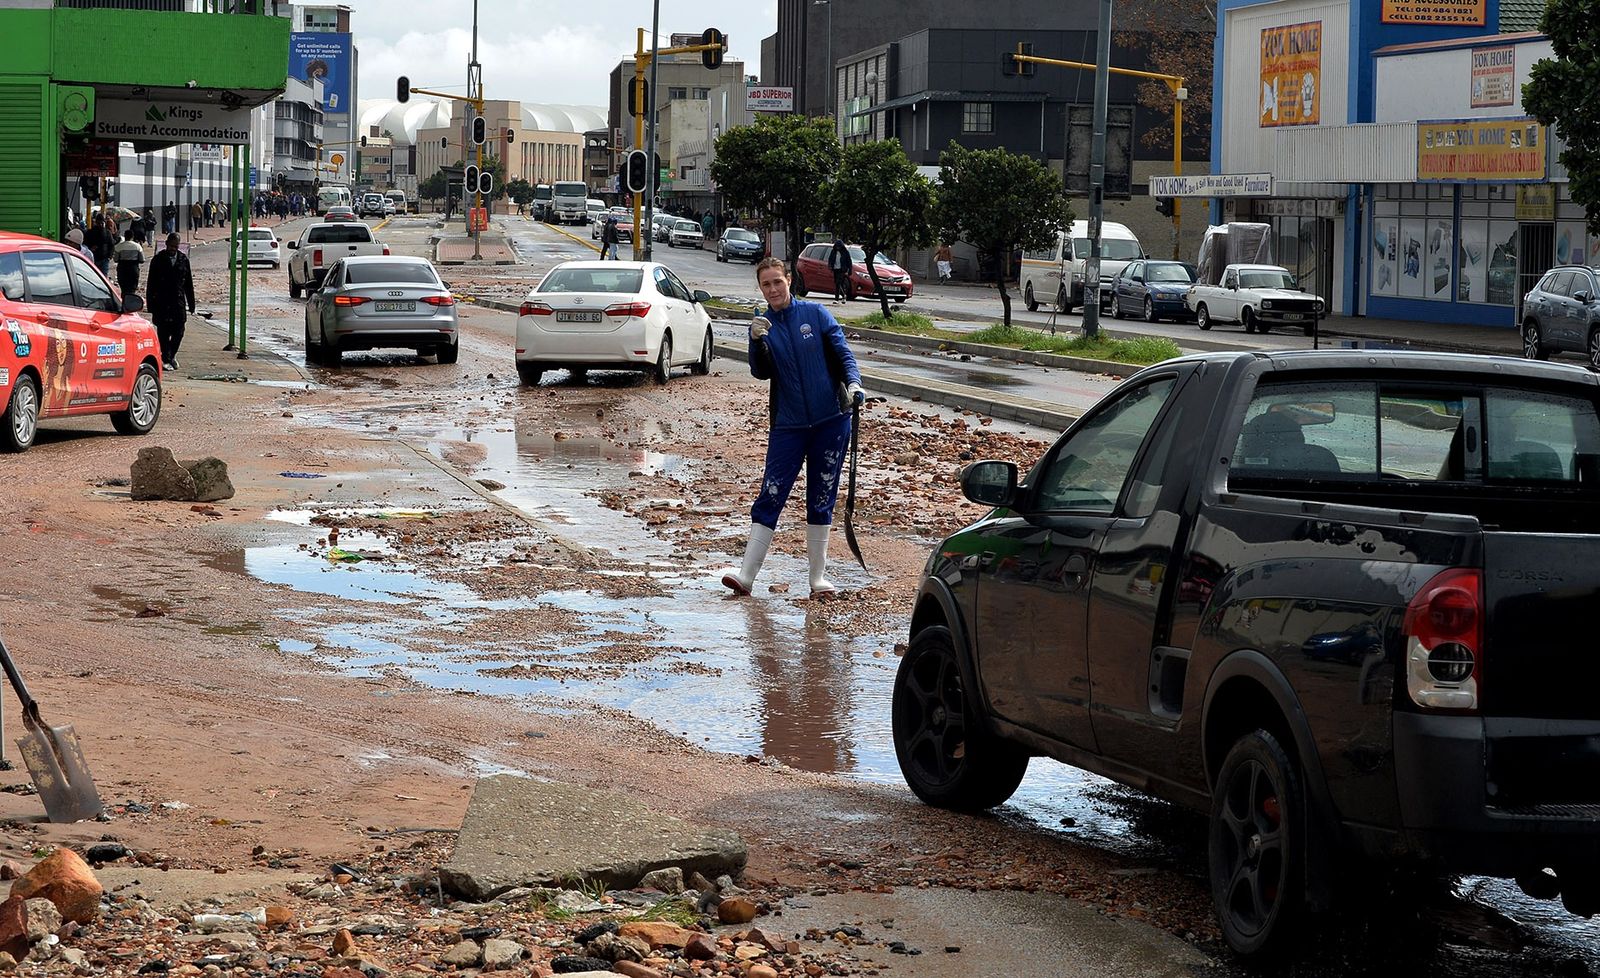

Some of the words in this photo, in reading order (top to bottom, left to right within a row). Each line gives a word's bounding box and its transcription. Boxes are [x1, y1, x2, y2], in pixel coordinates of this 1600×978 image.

[1289, 29, 1318, 54] HOME
[1474, 53, 1488, 67] YOK
[1490, 50, 1512, 66] HOME
[748, 90, 761, 98] JBD
[762, 89, 792, 99] SUPERIOR
[169, 106, 203, 121] Kings
[98, 122, 147, 135] Student
[150, 124, 248, 139] Accommodation
[1456, 129, 1474, 145] YOK
[1478, 128, 1505, 145] HOME
[1155, 178, 1168, 194] YOK
[1169, 177, 1187, 194] HOME
[1199, 178, 1207, 189] Sell
[1207, 178, 1215, 187] New
[1223, 177, 1233, 187] Good
[1234, 176, 1244, 186] Used
[1244, 177, 1269, 192] Furniture
[17, 331, 29, 344] You
